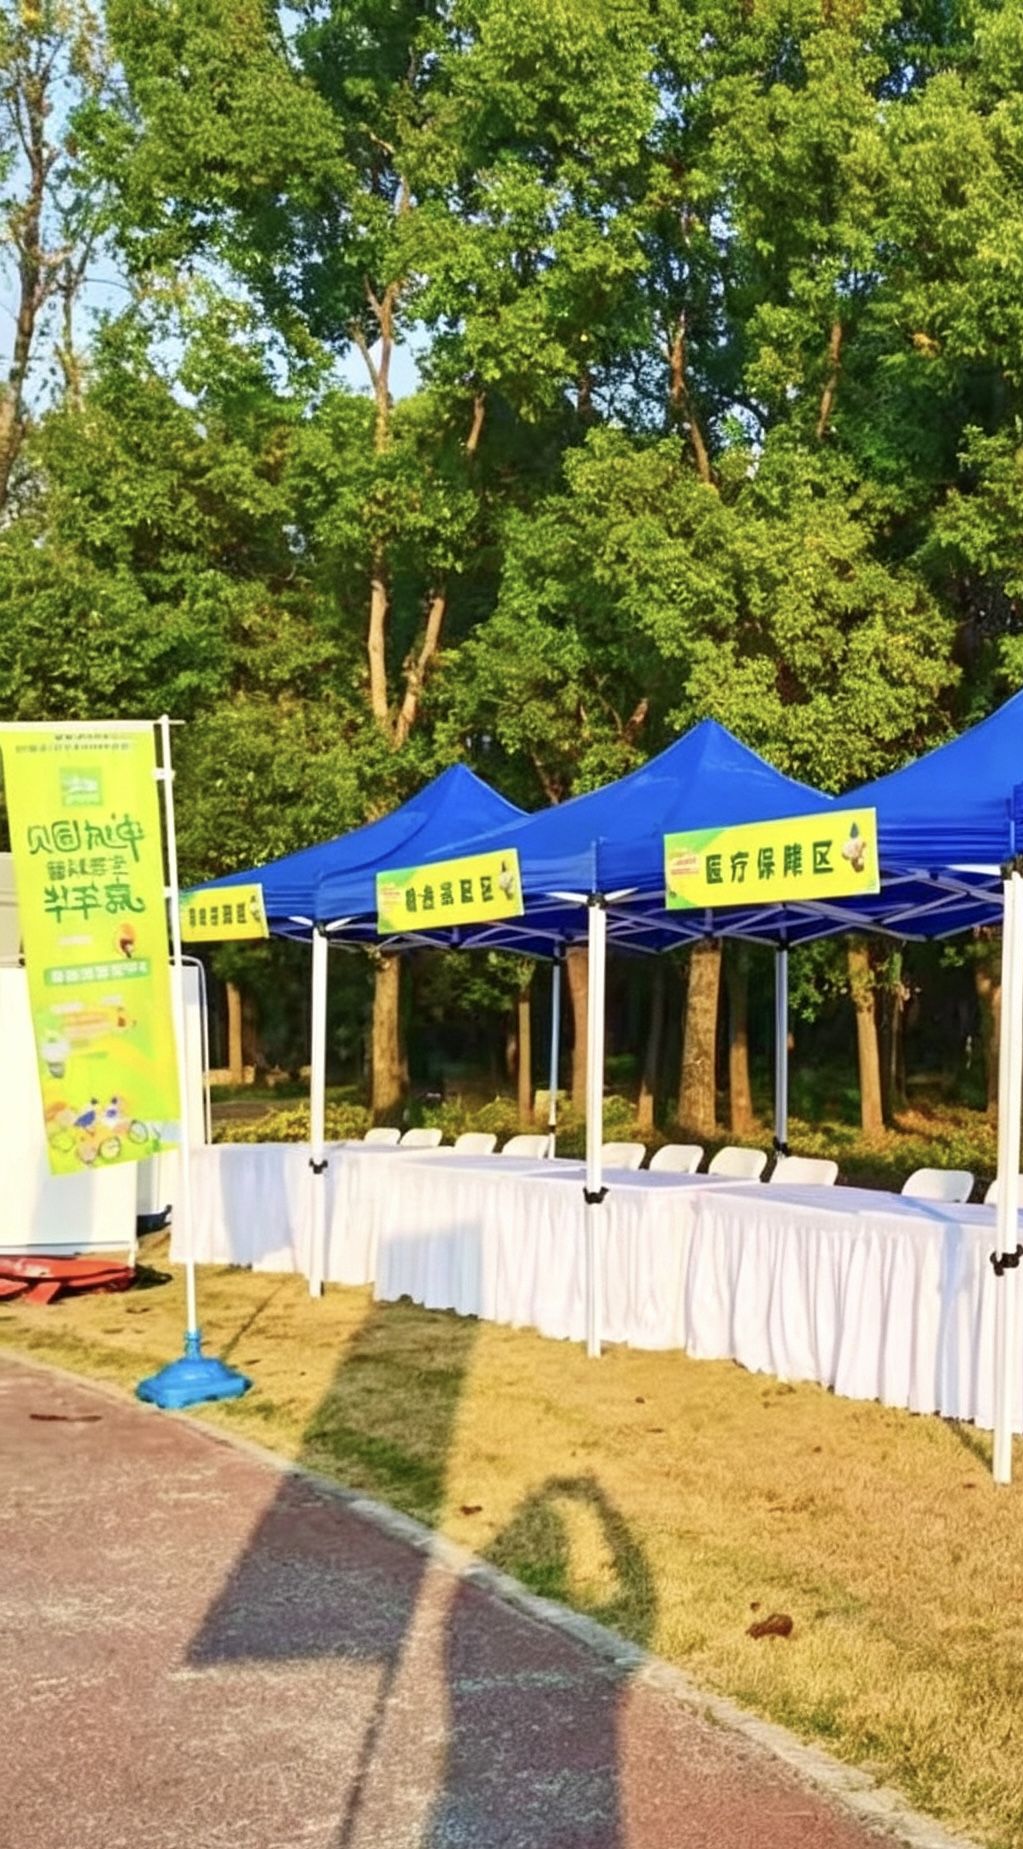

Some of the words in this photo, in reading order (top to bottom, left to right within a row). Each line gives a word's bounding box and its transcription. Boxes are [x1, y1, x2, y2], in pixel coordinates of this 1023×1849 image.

[705, 840, 833, 884] 医疗保障区
